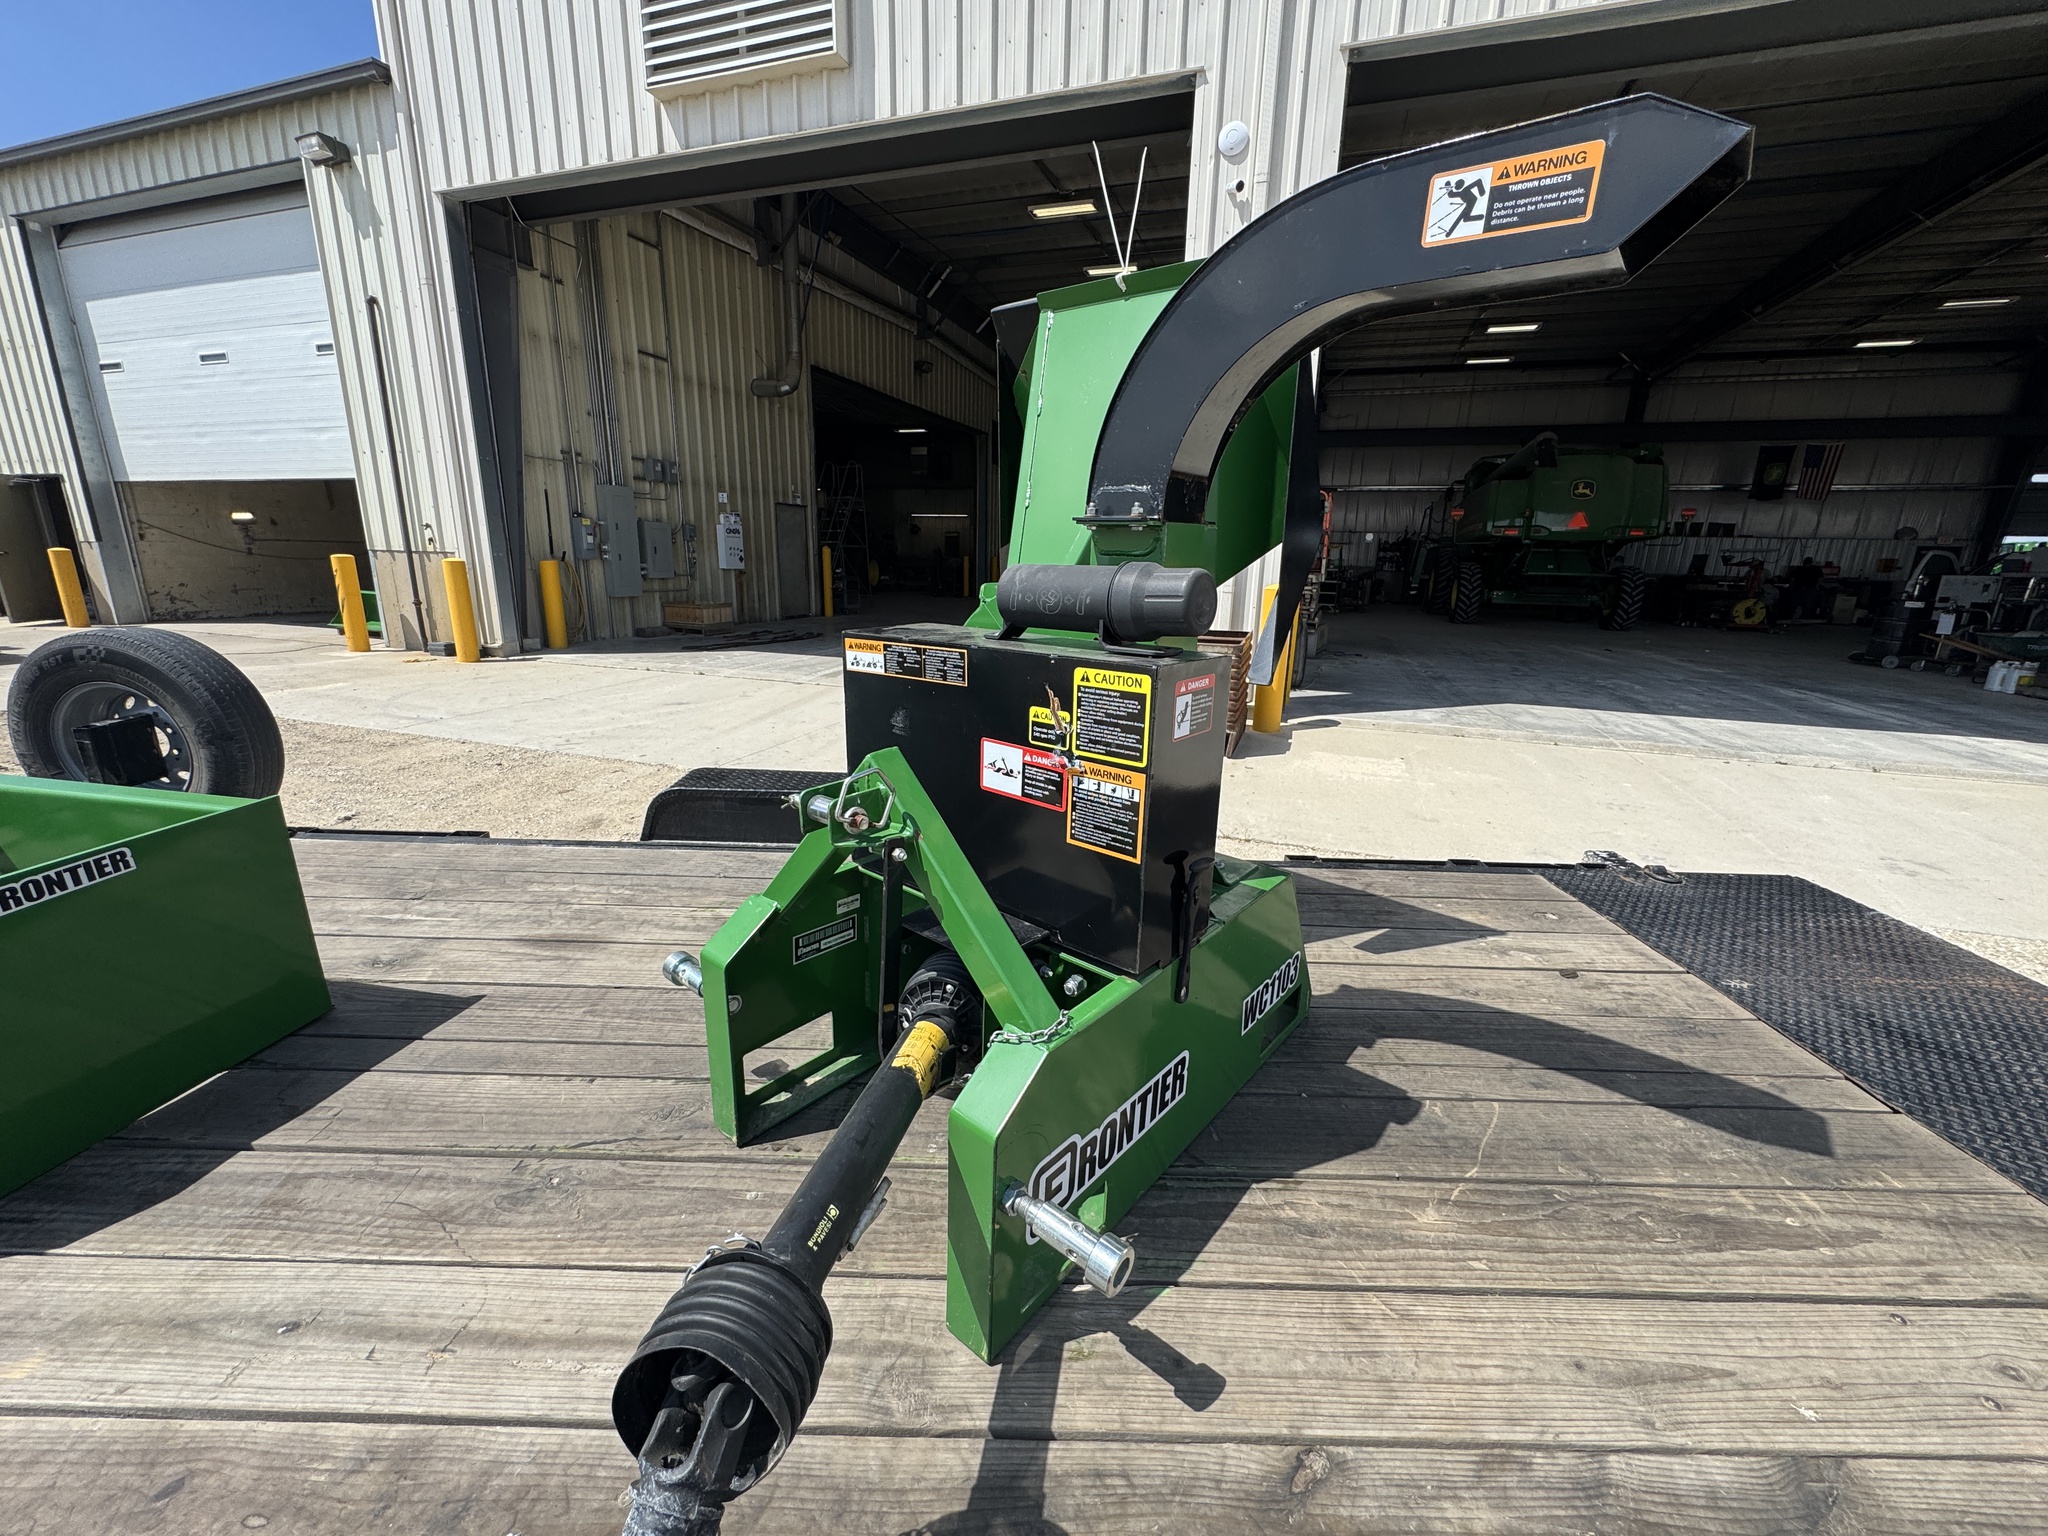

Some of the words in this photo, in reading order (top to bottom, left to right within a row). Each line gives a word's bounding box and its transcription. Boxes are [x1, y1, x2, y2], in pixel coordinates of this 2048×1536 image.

[1513, 151, 1588, 177] WARNING
[1508, 180, 1539, 192] THROWN
[1540, 174, 1572, 186] OBJECTS
[1492, 208, 1513, 218] Debris
[1537, 199, 1561, 210] thrown
[1568, 196, 1585, 204] long
[1493, 202, 1503, 210] Do
[1516, 196, 1542, 206] operate
[1560, 187, 1586, 198] people.
[1490, 216, 1519, 226] distance.
[853, 642, 882, 652] WARNING
[1093, 673, 1143, 689] CAUTION
[1187, 678, 1210, 690] DANGER
[1040, 711, 1067, 724] CAUON
[1032, 755, 1061, 769] DANG
[1088, 766, 1132, 785] WARNING
[1243, 953, 1300, 1031] WC1103
[1032, 1055, 1188, 1208] FRONTIER
[807, 1215, 829, 1247] BONDIOLI
[817, 1220, 833, 1244] PAVESI
